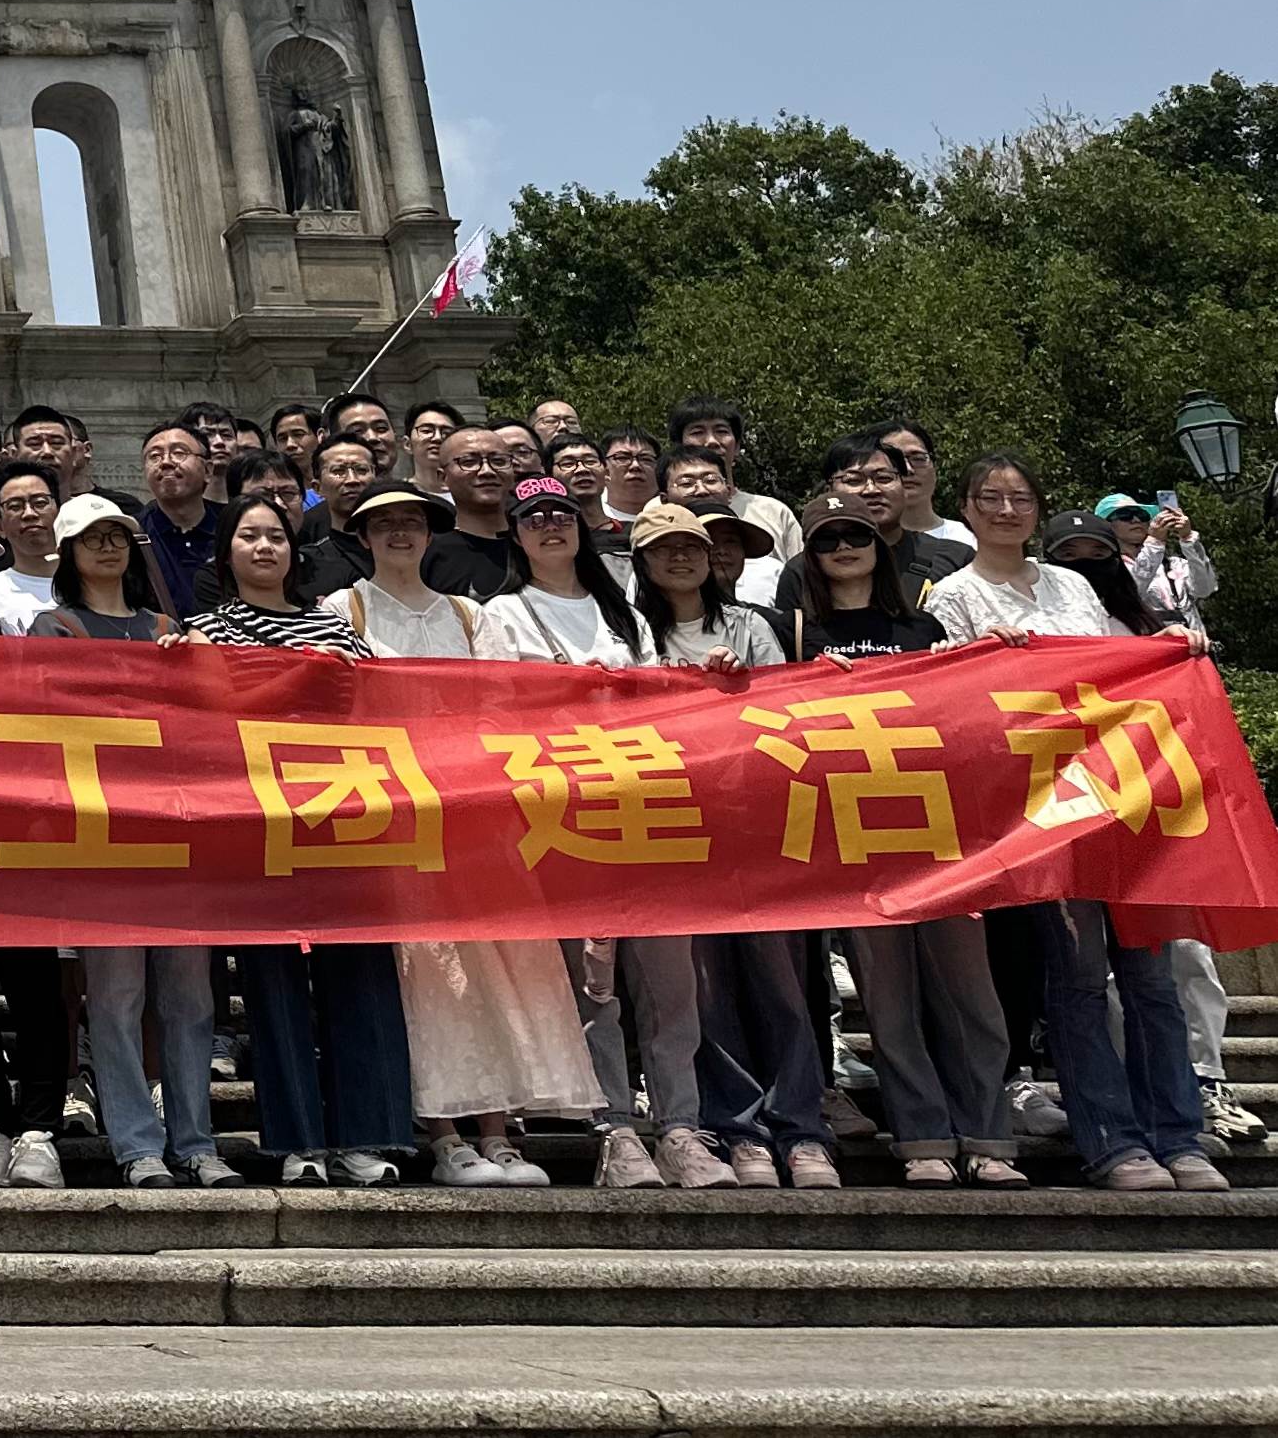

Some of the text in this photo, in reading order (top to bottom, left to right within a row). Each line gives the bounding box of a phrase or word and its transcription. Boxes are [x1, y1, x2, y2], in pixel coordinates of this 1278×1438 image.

[827, 497, 844, 510] R
[823, 639, 903, 656] good things
